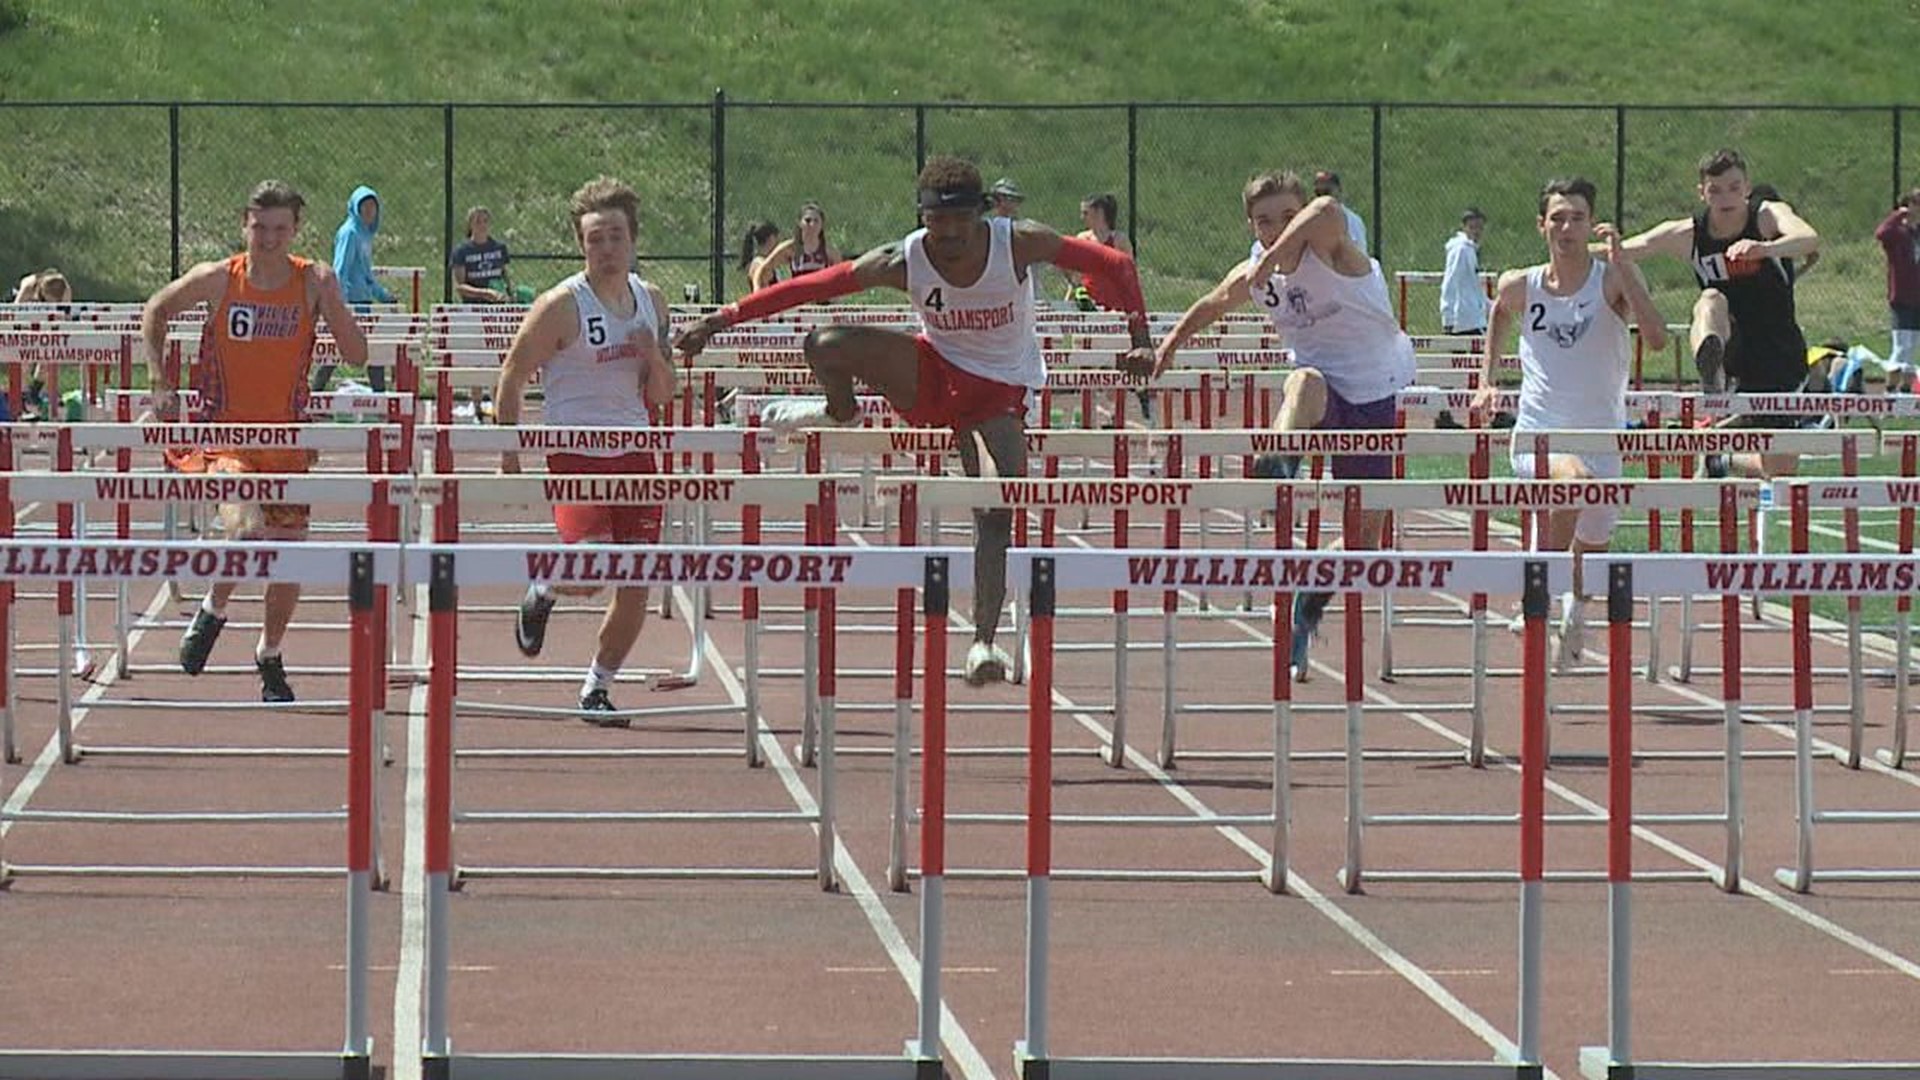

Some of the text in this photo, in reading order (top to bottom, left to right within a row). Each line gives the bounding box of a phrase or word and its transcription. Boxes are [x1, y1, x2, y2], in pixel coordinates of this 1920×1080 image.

[925, 287, 944, 311] 4
[1265, 281, 1280, 307] 3
[231, 309, 249, 337] 6
[924, 301, 1014, 331] WILLIAMSPORT
[1530, 303, 1546, 332] 2
[587, 316, 606, 345] 5
[708, 336, 797, 346] ILLIAMSPORT
[1060, 325, 1126, 334] WILLIAMSP
[20, 348, 120, 361] WILLIAMSPORT
[738, 352, 803, 364] WILLIAMS
[765, 372, 817, 385] WILLIA
[1749, 398, 1896, 412] WILLIAMSPORT
[143, 427, 301, 446] WILLIAMSPORT
[519, 430, 675, 449] WILLIAMSPORT
[1251, 433, 1407, 452] WILLIAMSPORT
[1616, 434, 1774, 451] WILLIAMSPORT
[97, 478, 289, 501] WILLIAMSPORT
[544, 479, 735, 502] WILLIAMSPORT
[1001, 482, 1193, 505] WILLIAMSPORT
[1444, 483, 1635, 505] WILLIAMSPORT
[1822, 486, 1858, 499] GILL
[0, 547, 278, 577] LLIAMSPORT
[526, 552, 852, 583] WILLIAMSPORT
[1128, 557, 1452, 589] WILLIAMSPORT
[1706, 562, 1920, 591] WILLIAMS
